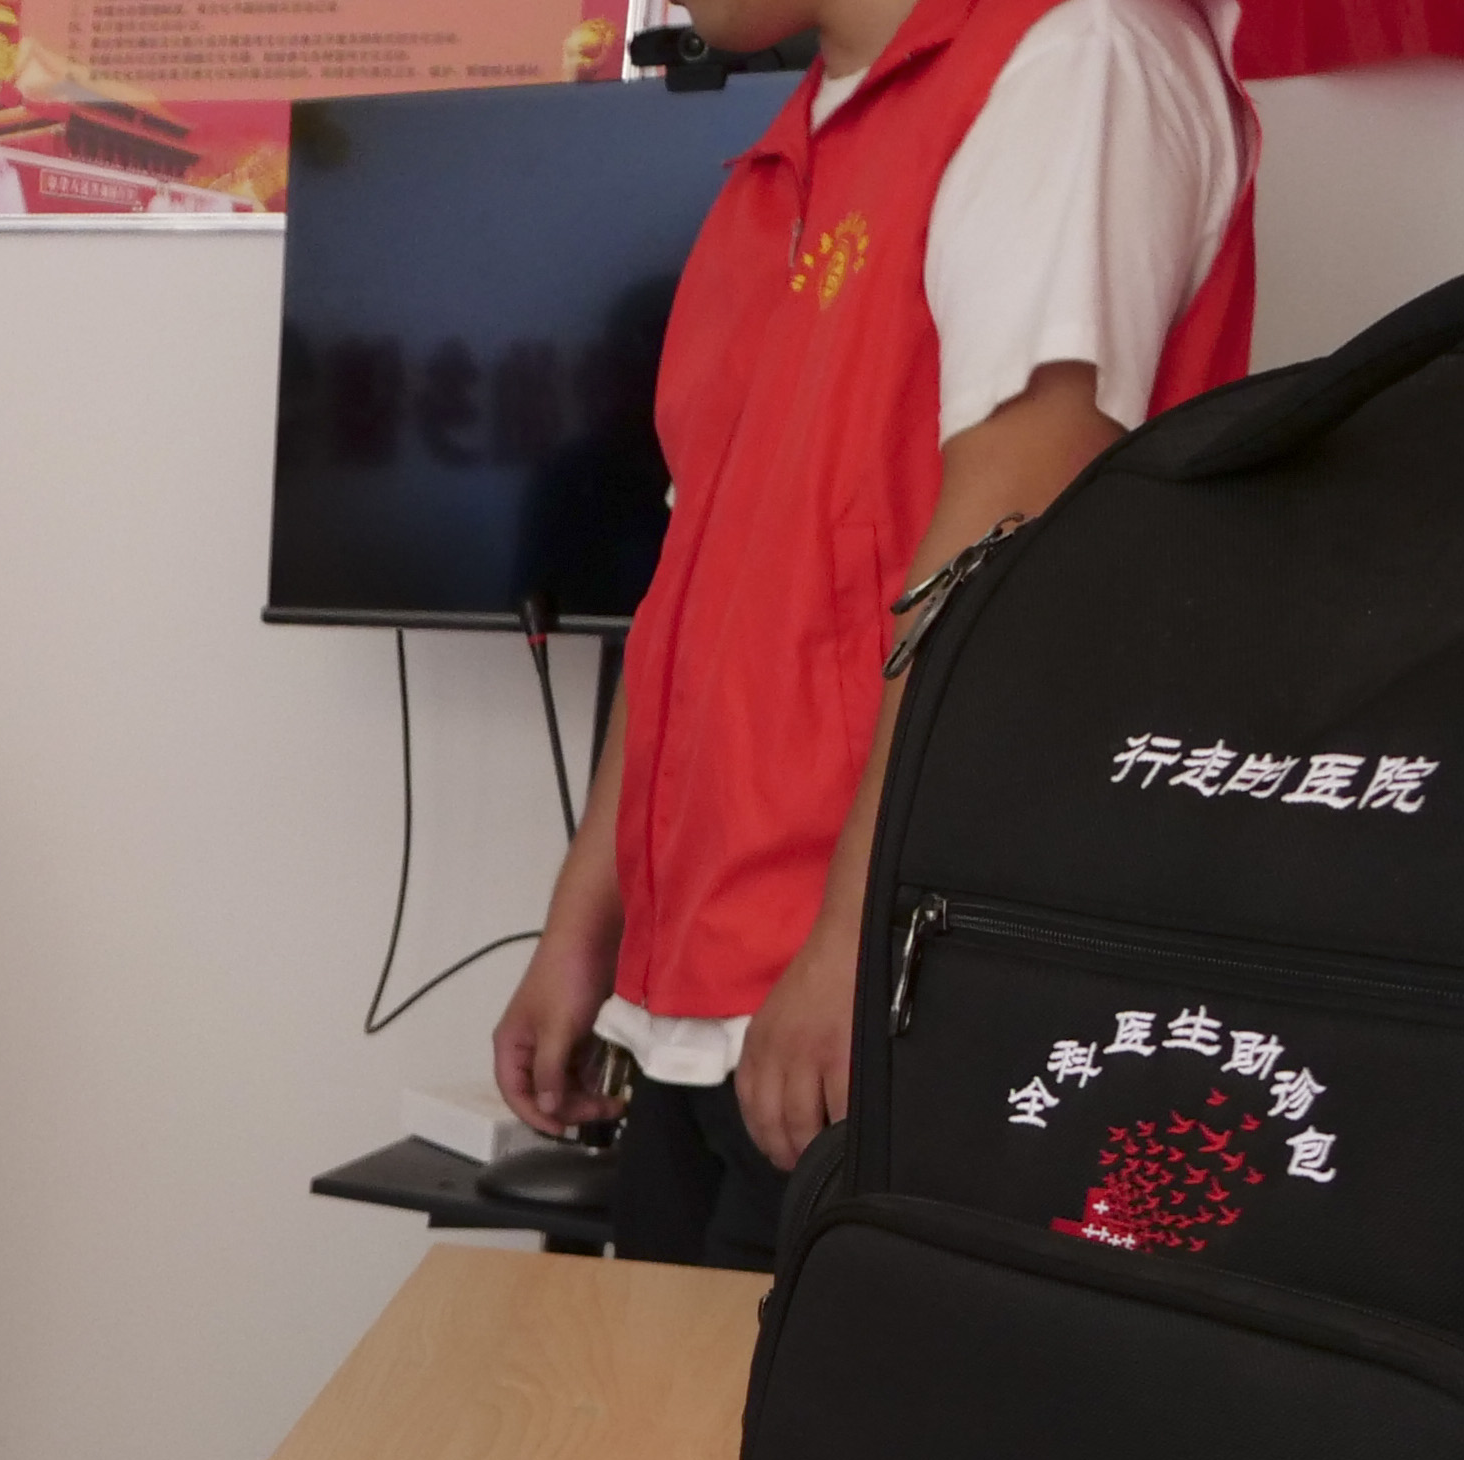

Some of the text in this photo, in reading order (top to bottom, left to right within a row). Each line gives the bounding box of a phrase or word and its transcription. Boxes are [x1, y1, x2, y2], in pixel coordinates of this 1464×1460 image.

[1110, 732, 1440, 813] 行走的医院
[1008, 1005, 1337, 1183] 全科医生助诊包
